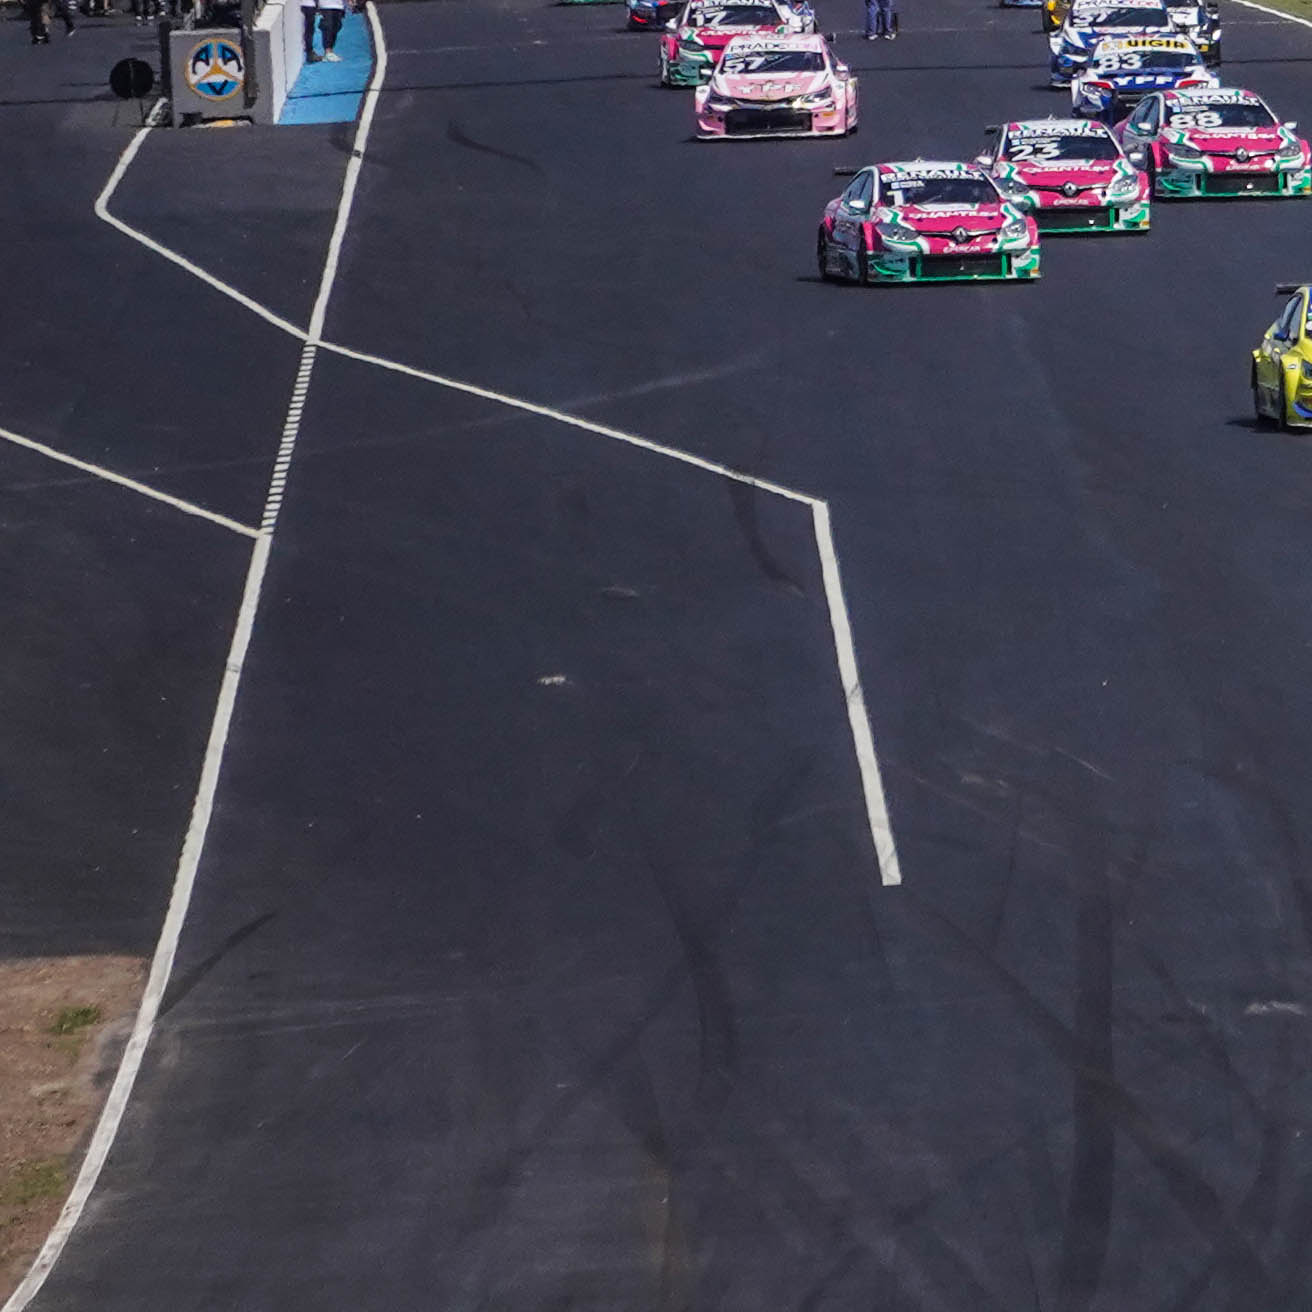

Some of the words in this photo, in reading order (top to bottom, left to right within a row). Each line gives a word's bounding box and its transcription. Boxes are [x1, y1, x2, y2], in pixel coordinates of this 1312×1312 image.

[1099, 53, 1142, 70] 83
[1166, 94, 1260, 106] RENAULT
[1169, 111, 1223, 129] 88
[1009, 143, 1061, 162] 23
[880, 168, 984, 184] RENAULT
